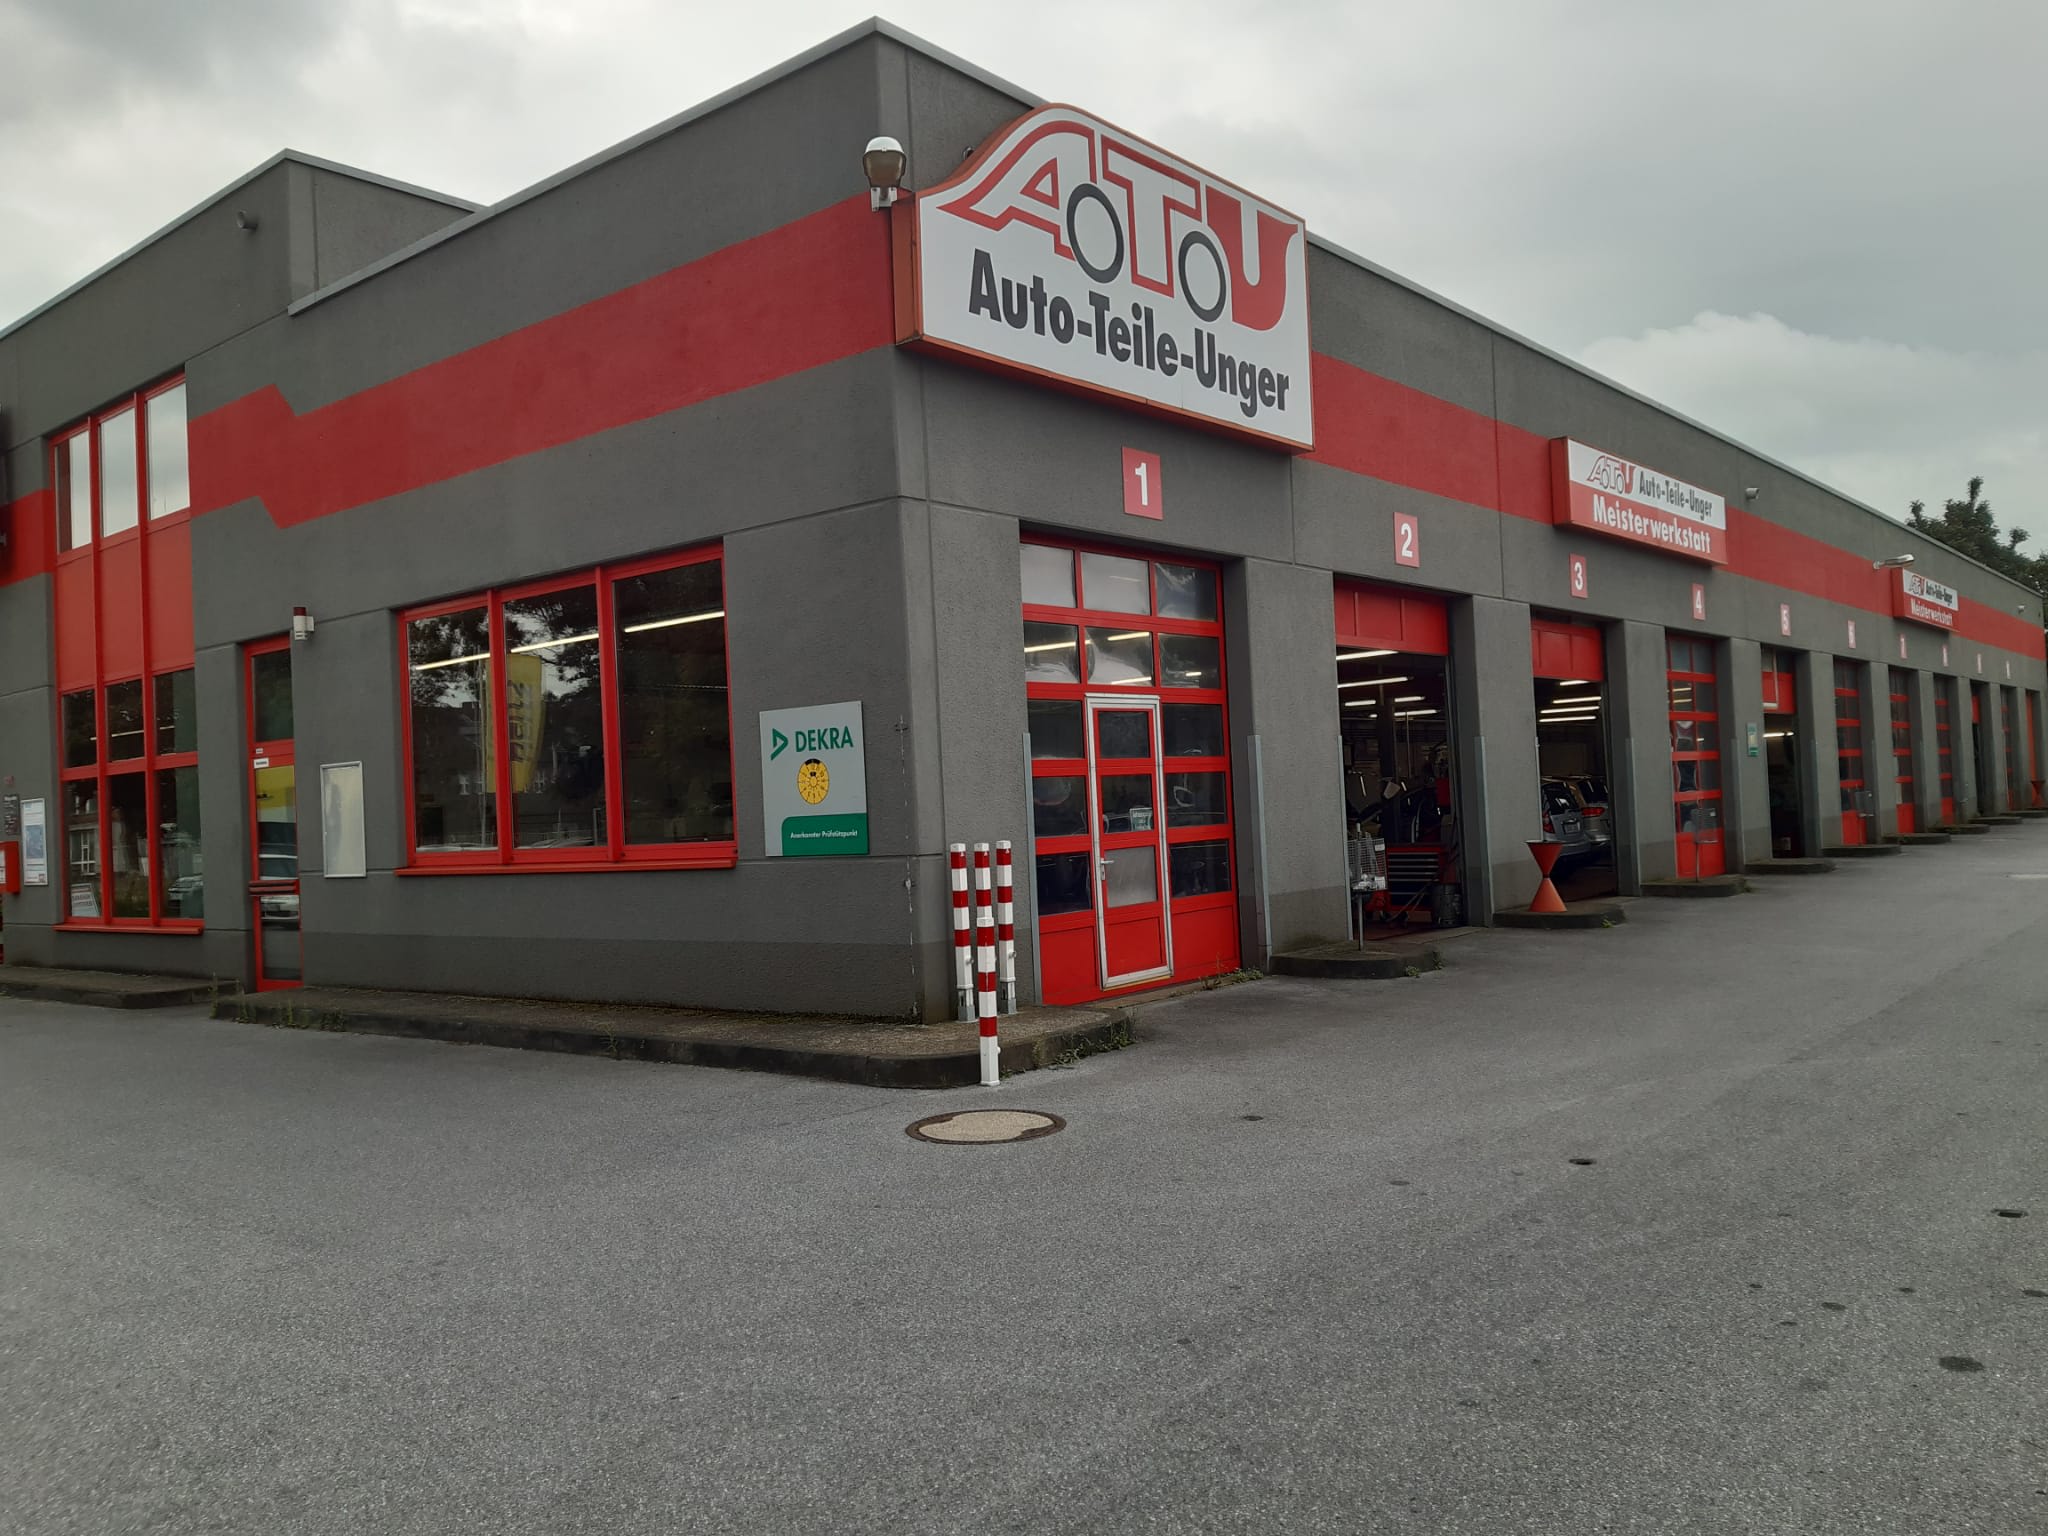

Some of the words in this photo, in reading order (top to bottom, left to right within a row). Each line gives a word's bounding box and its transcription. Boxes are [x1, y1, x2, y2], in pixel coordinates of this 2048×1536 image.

[968, 248, 1290, 418] Auto-Teile-Unger
[1134, 462, 1149, 507] 1
[1639, 470, 1713, 521] Auto-Teile-Unger
[1400, 522, 1413, 558] 2
[1592, 493, 1712, 554] Meisterwerkstatt
[1573, 561, 1584, 591] 3
[1695, 589, 1703, 614] 4
[795, 725, 854, 753] DEKRA
